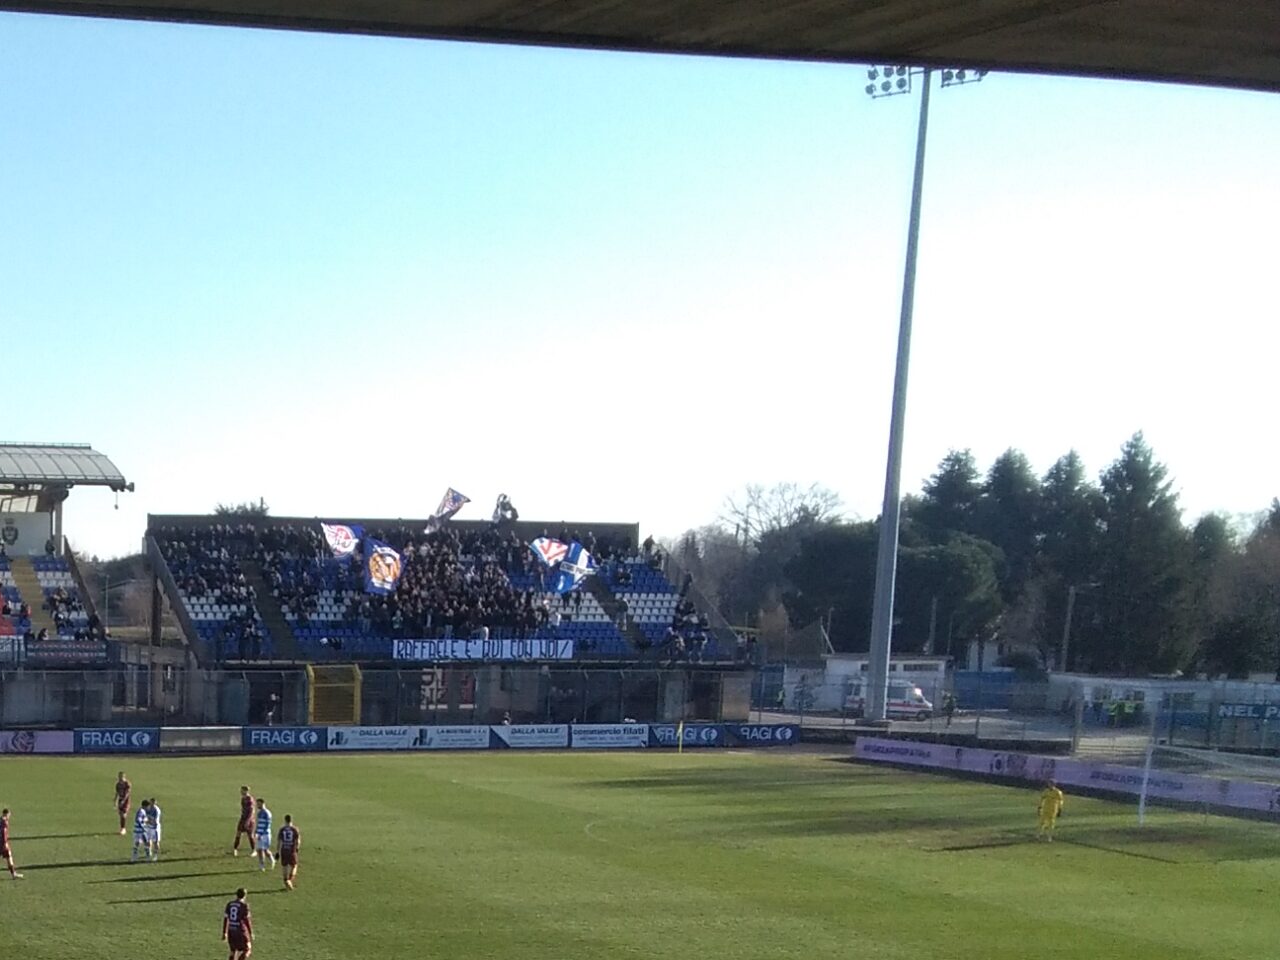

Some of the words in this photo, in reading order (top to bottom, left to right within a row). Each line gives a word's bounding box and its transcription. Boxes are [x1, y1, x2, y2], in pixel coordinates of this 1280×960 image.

[396, 640, 458, 659] RAFFAELE
[482, 640, 503, 659] QUI
[510, 640, 533, 659] CON
[1219, 704, 1260, 718] NEL
[1265, 705, 1280, 719] P
[82, 731, 128, 746] FRAGI
[250, 730, 296, 745] FRAGI
[573, 728, 621, 736] commercio
[623, 727, 645, 736] filati
[283, 830, 294, 842] 13
[229, 906, 238, 921] 8
